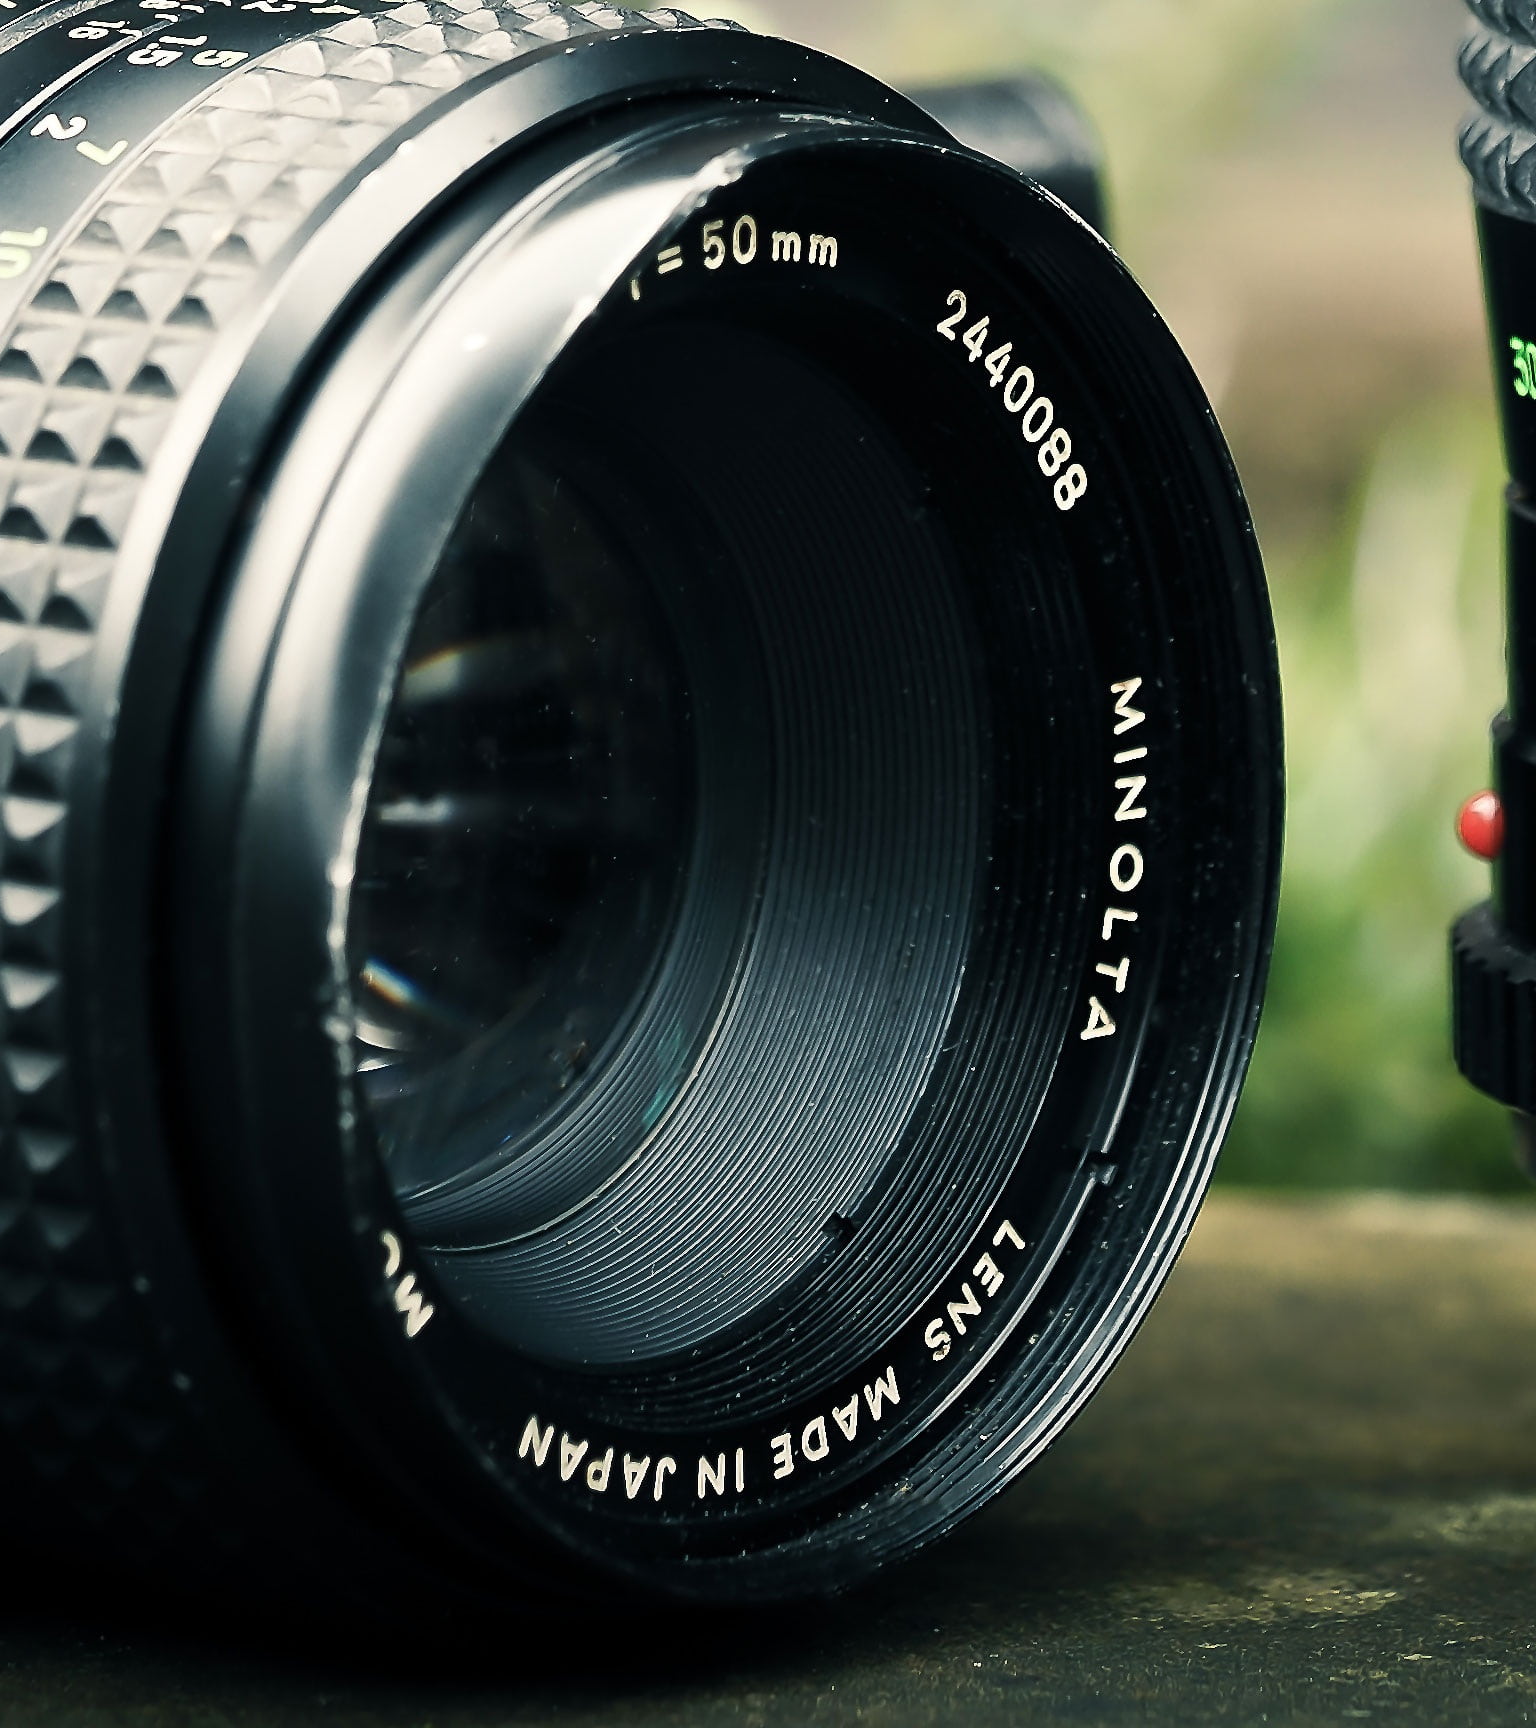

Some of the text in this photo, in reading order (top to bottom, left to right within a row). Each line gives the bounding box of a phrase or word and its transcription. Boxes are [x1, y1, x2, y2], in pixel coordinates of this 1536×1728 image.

[31, 112, 90, 142] 2
[936, 289, 1087, 510] 2440088
[1080, 676, 1148, 1041] MINOLTA
[518, 1219, 1029, 1502] LENS MADE IN JAPAN
